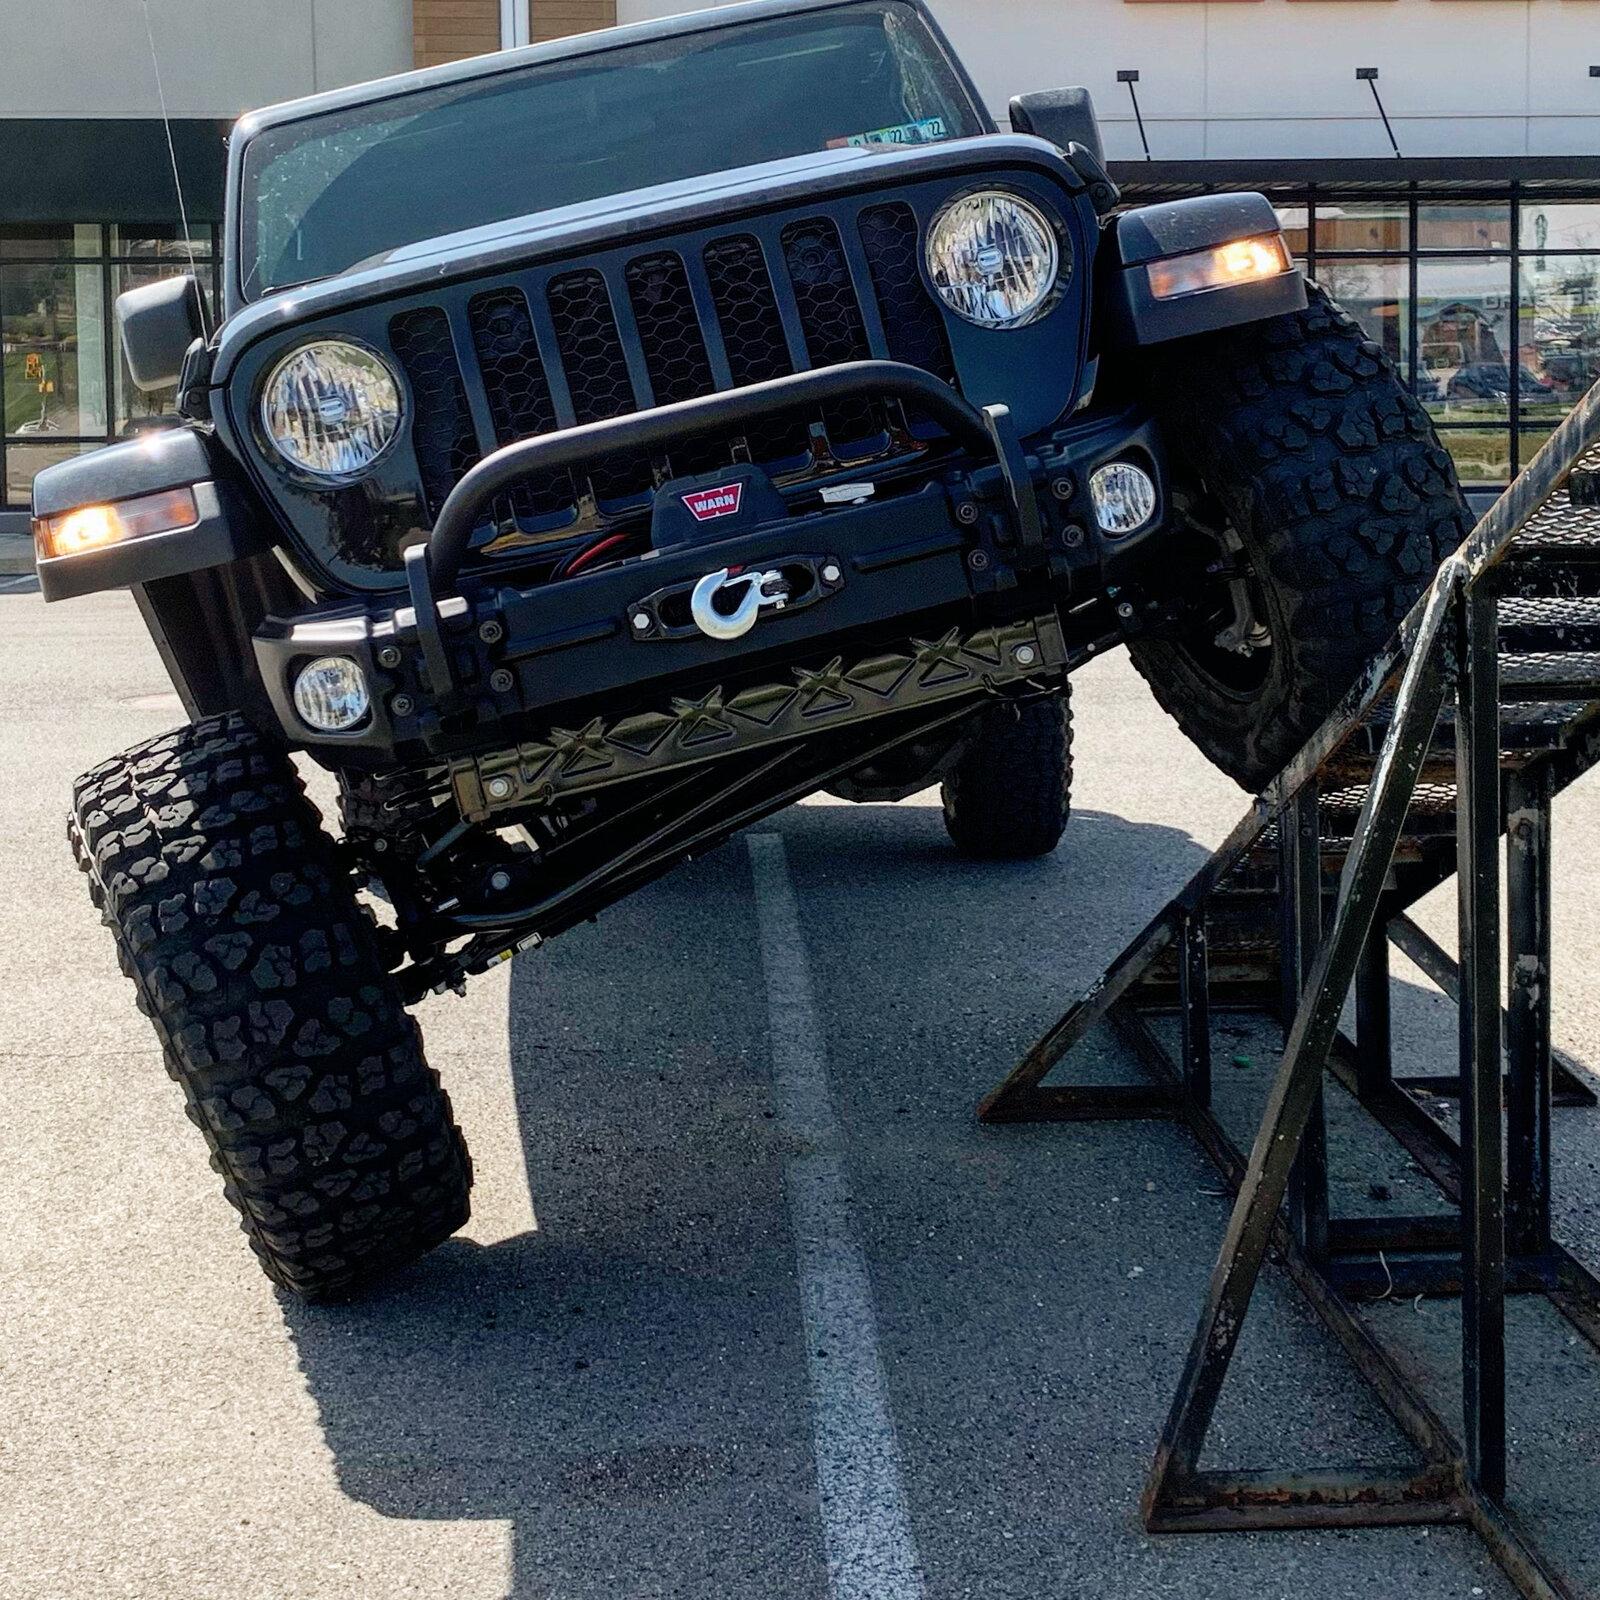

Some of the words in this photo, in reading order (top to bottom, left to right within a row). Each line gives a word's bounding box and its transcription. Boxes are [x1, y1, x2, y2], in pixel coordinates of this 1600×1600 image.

[928, 120, 944, 136] 22
[890, 129, 904, 144] 22
[694, 494, 735, 512] WARN
